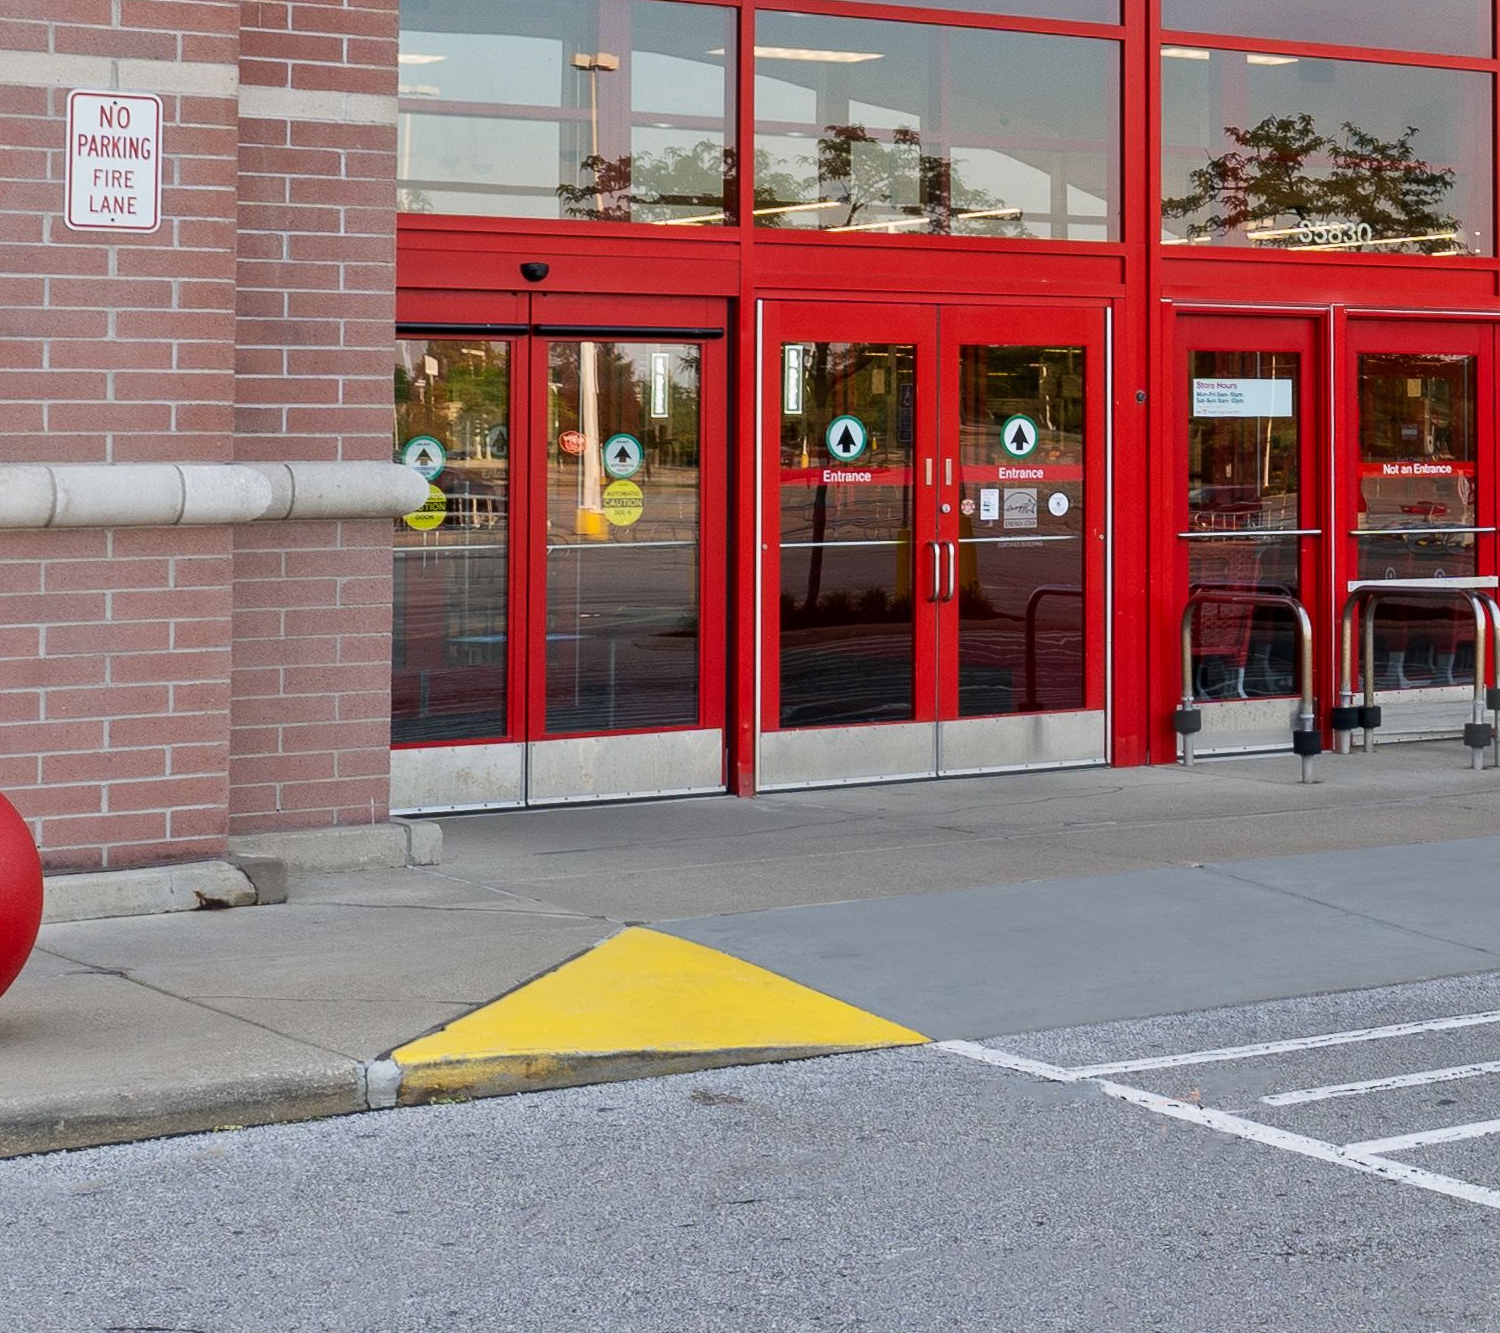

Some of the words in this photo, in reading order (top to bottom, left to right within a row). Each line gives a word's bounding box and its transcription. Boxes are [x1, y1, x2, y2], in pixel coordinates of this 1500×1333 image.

[99, 104, 131, 129] NO
[77, 133, 152, 160] PARKING
[93, 168, 135, 189] FIRE
[89, 194, 138, 215] LANE
[822, 469, 872, 483] Entrance
[998, 467, 1044, 479] Entrance
[1383, 463, 1399, 474] Not
[1400, 465, 1412, 474] an
[1413, 463, 1453, 474] Entrance
[603, 498, 643, 507] CAUTION
